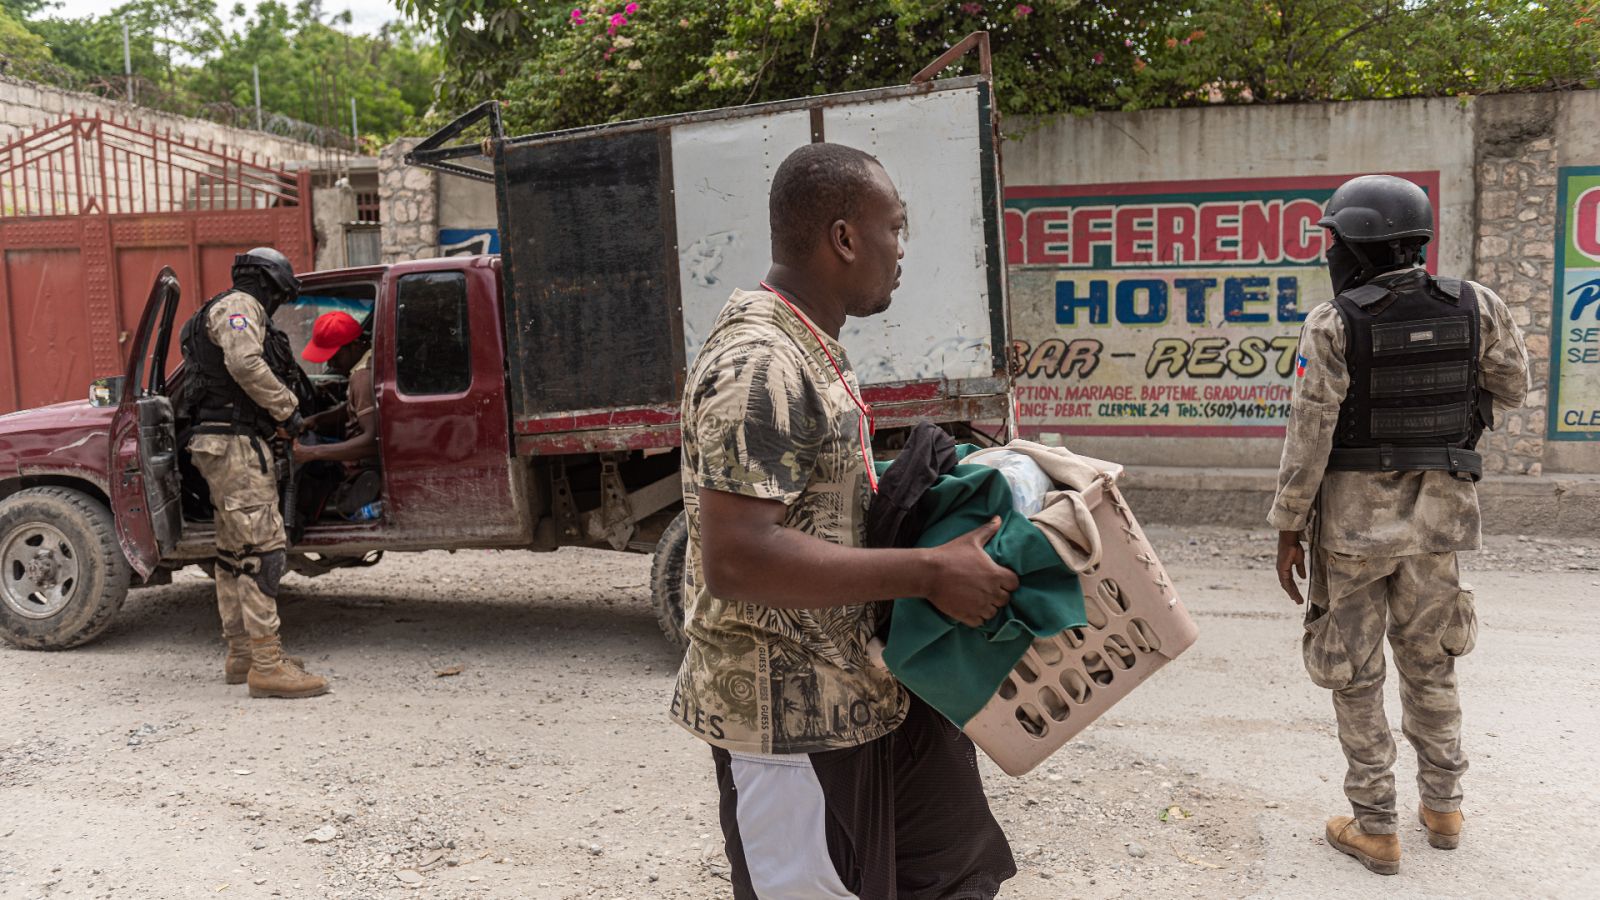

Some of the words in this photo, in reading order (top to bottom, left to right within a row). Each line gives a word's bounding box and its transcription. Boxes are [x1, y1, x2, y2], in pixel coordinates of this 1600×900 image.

[1004, 200, 1334, 266] REFERENC
[1055, 277, 1309, 325] HOTEL
[1150, 403, 1170, 417] 24
[757, 646, 766, 673] GUESS
[670, 690, 725, 740] ELES
[760, 704, 769, 730] GUESS
